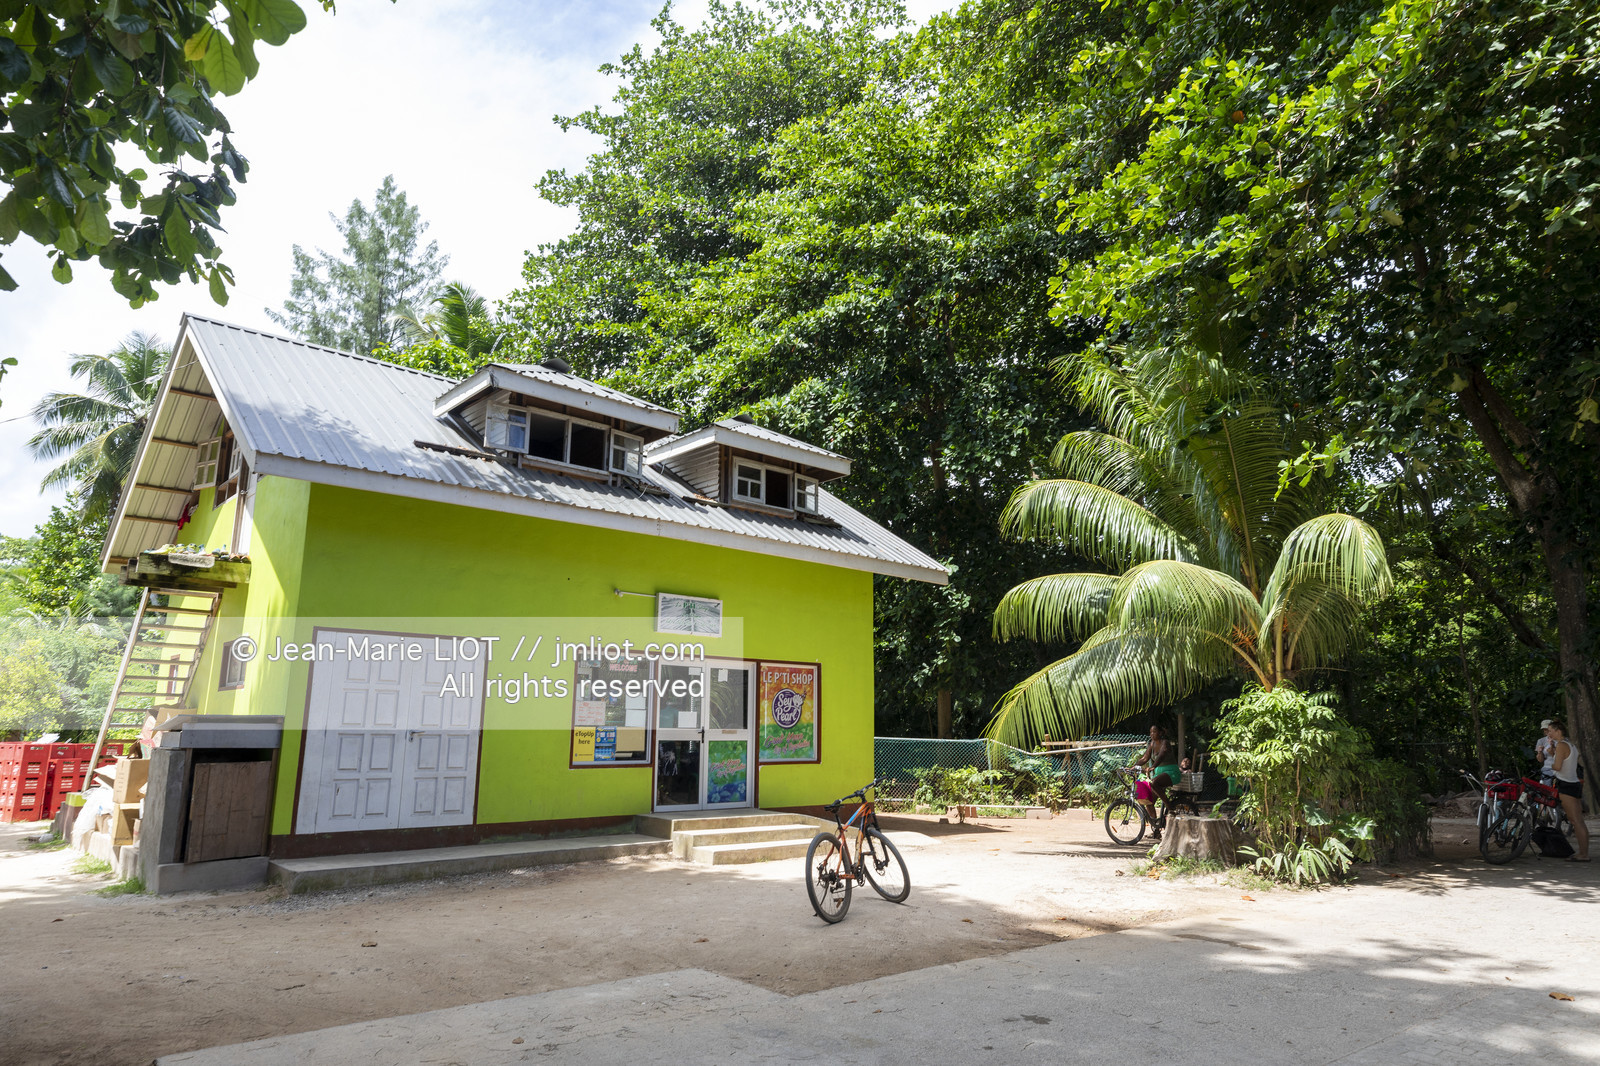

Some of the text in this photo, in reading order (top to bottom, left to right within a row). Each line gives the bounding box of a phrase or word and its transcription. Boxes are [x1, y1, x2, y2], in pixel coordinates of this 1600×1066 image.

[609, 663, 638, 672] WELCOME
[762, 671, 813, 685] LE P'TI SHOP
[777, 693, 793, 713] Sey
[775, 706, 799, 722] Pearl
